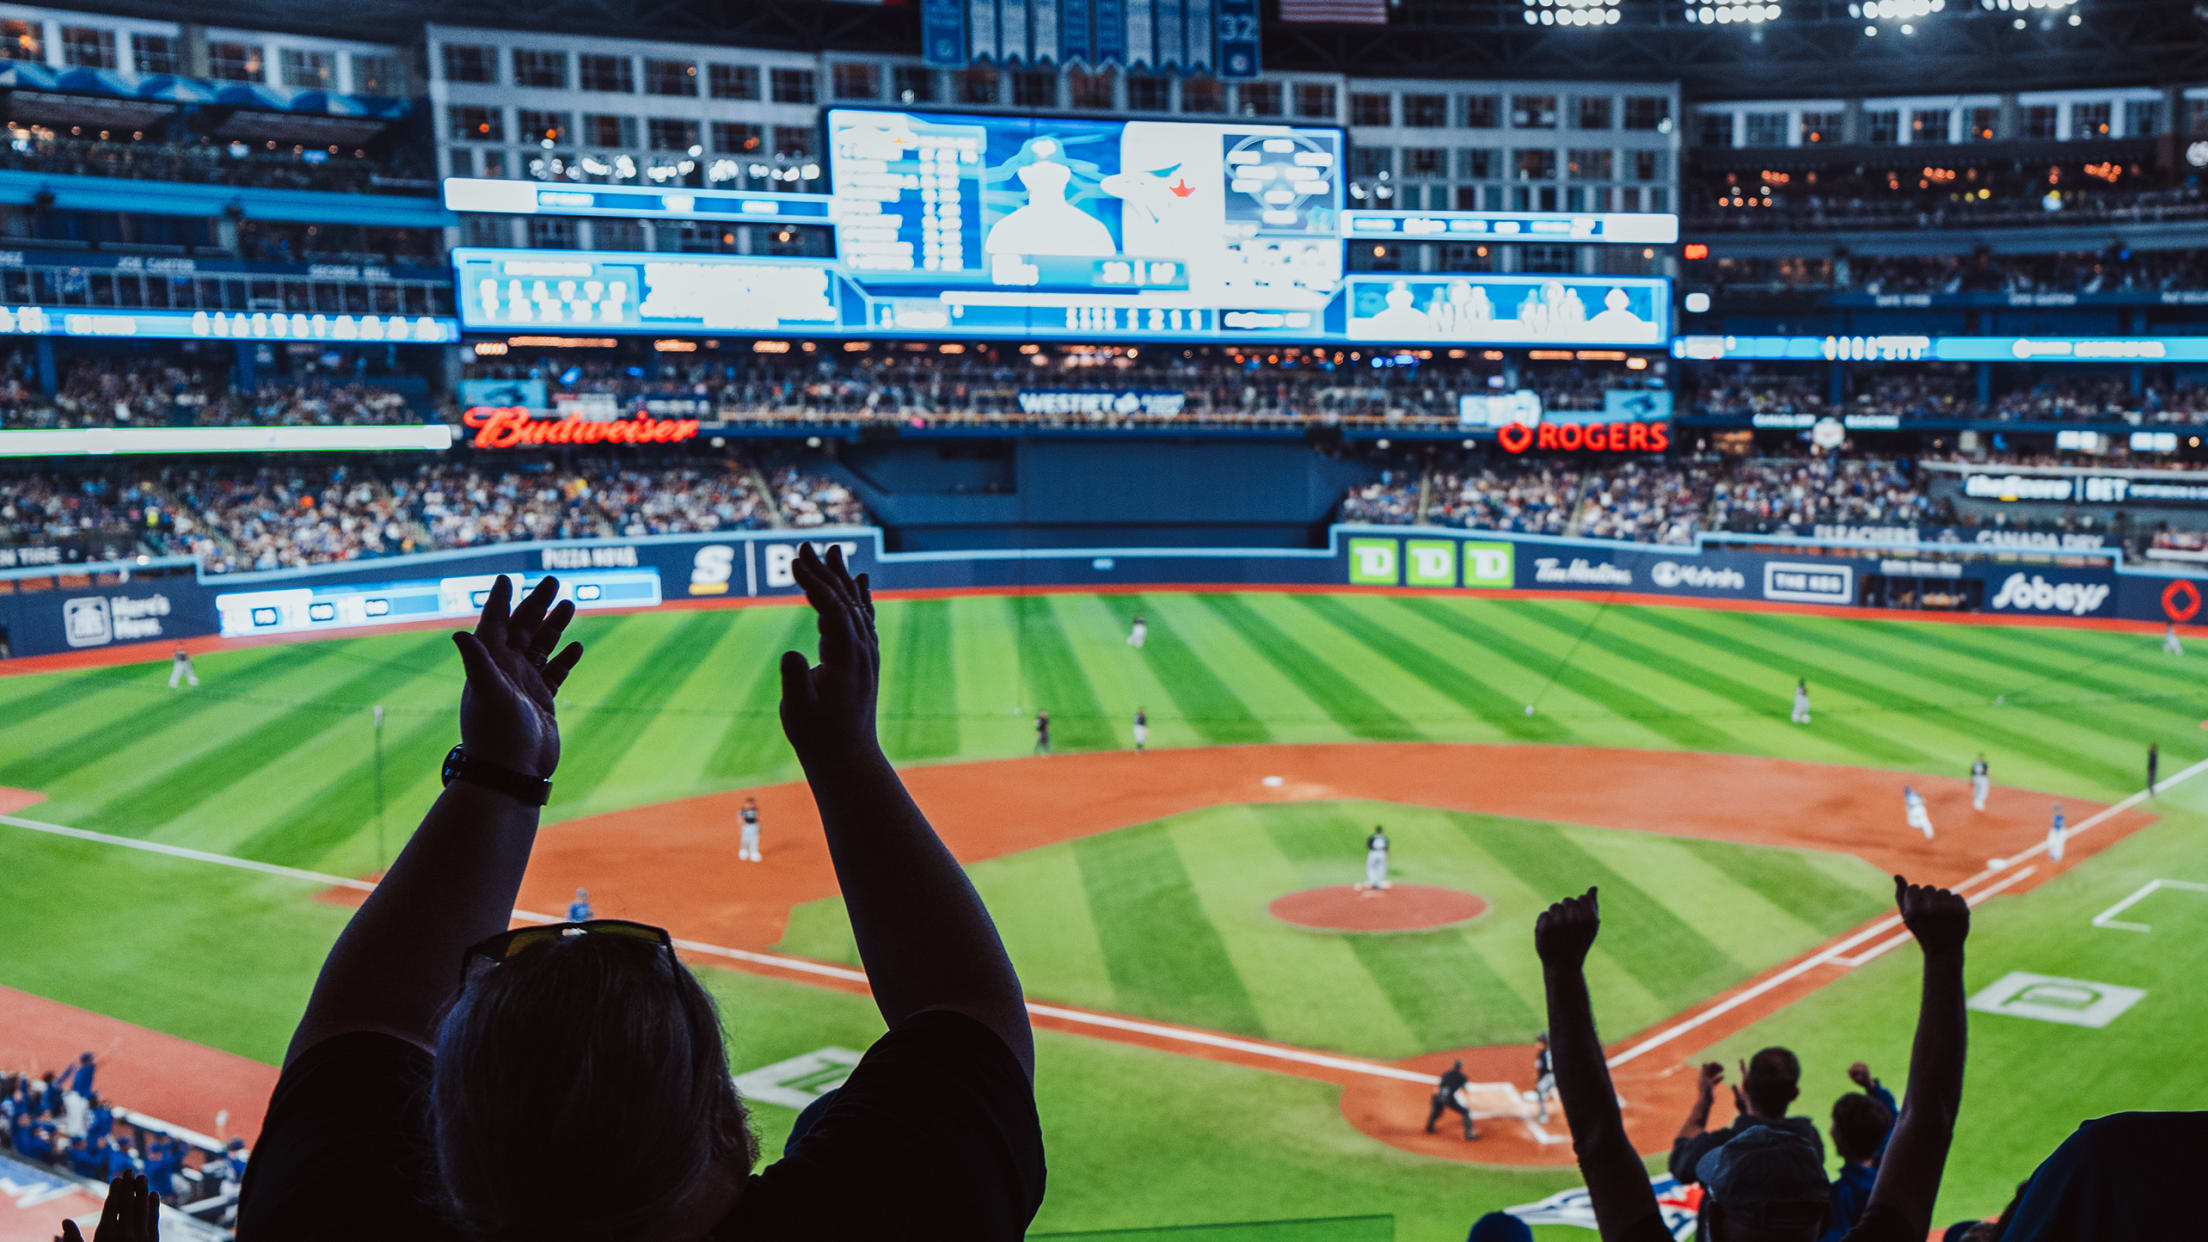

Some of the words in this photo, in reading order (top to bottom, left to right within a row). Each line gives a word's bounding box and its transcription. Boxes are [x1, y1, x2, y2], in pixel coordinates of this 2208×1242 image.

[463, 405, 699, 449] Budweiser
[1528, 422, 1669, 452] ROGERS
[1354, 546, 1395, 576] TD
[1410, 547, 1452, 578] TD
[1468, 548, 1510, 580] TD
